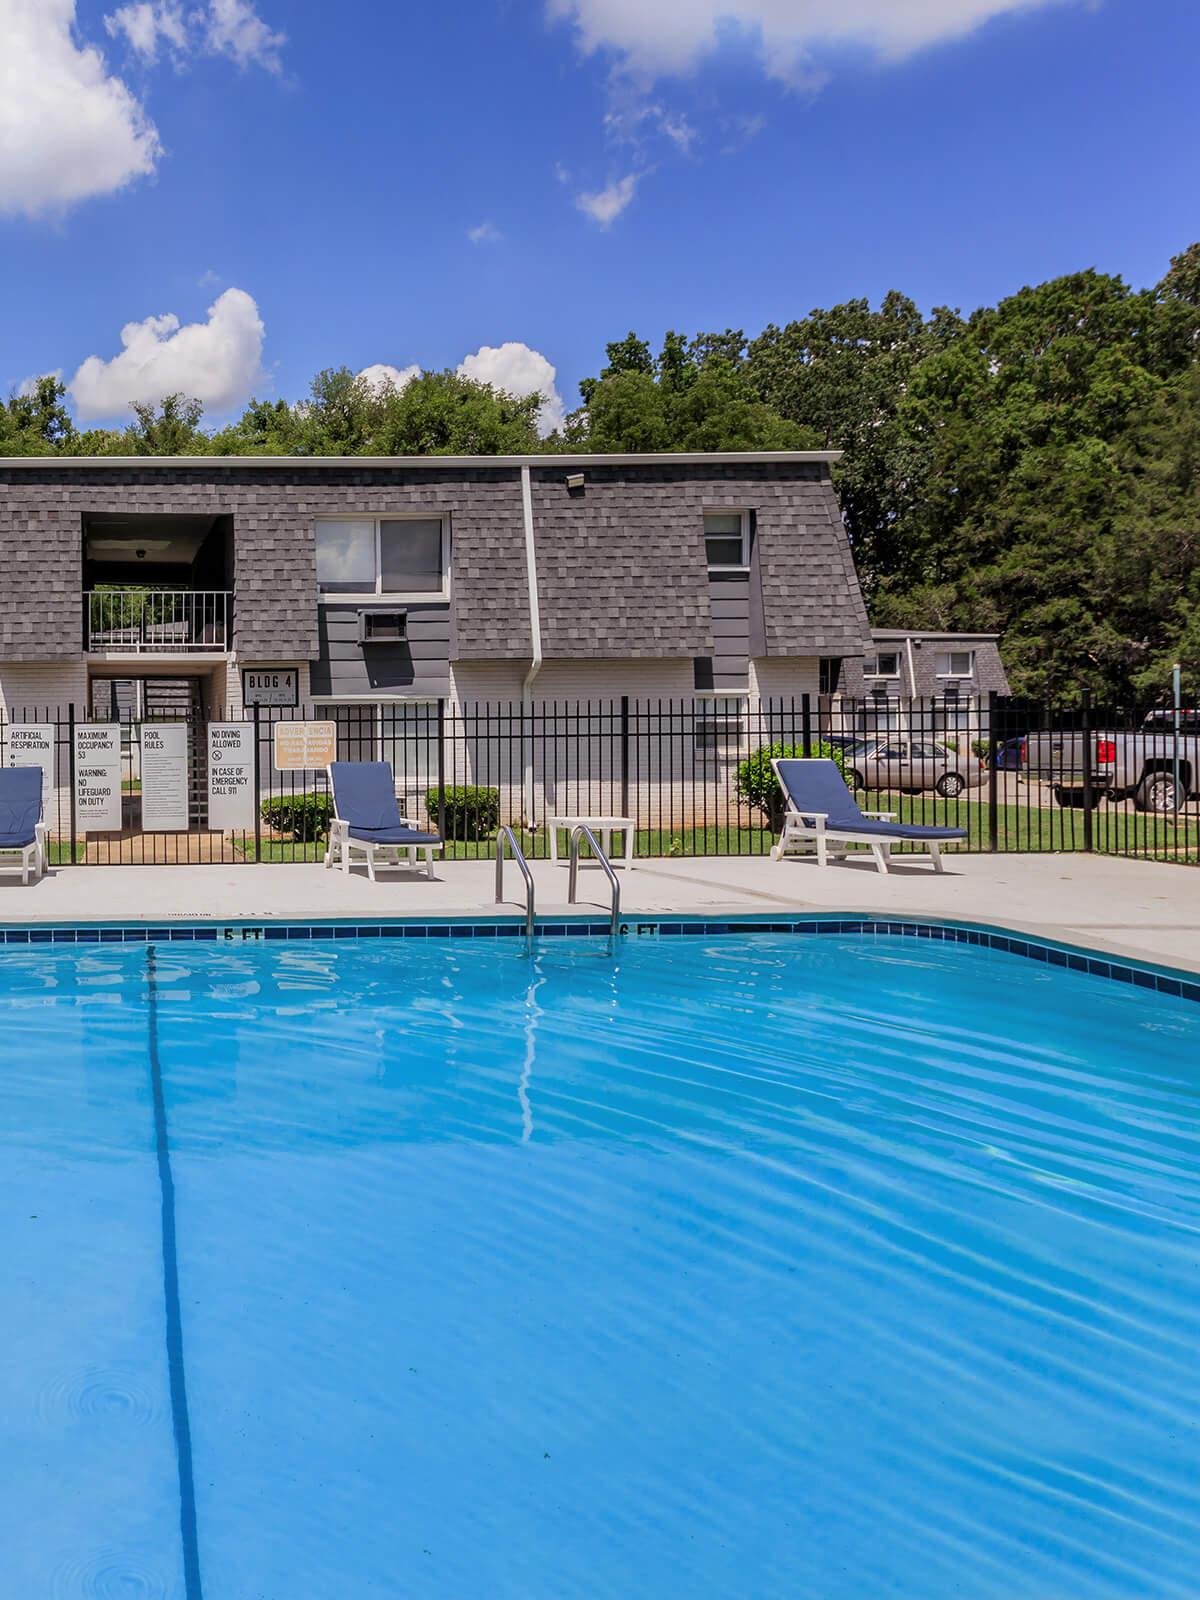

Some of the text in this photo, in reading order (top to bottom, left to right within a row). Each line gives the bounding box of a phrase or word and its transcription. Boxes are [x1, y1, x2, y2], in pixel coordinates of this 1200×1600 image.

[249, 675, 291, 688] BLDG 4
[11, 731, 43, 740] ARTIFICIAL
[77, 732, 108, 740] MAXIMUM
[144, 731, 160, 740] POOL
[211, 730, 241, 739] NO DIVING
[11, 741, 50, 749] RESPIRATION
[78, 741, 113, 750] OCCUPANCY
[144, 740, 164, 750] RULES
[211, 739, 241, 748] ALLOWED
[78, 751, 86, 759] 53
[211, 767, 244, 776] IN CASE OF
[78, 778, 87, 787] NO
[211, 776, 248, 785] EMERGENCY
[79, 788, 111, 796] LIFEGUARD
[211, 786, 237, 795] CALL 911
[78, 797, 104, 806] ON DUTY
[619, 923, 658, 935] 6 FT
[224, 928, 263, 940] 5 FT
